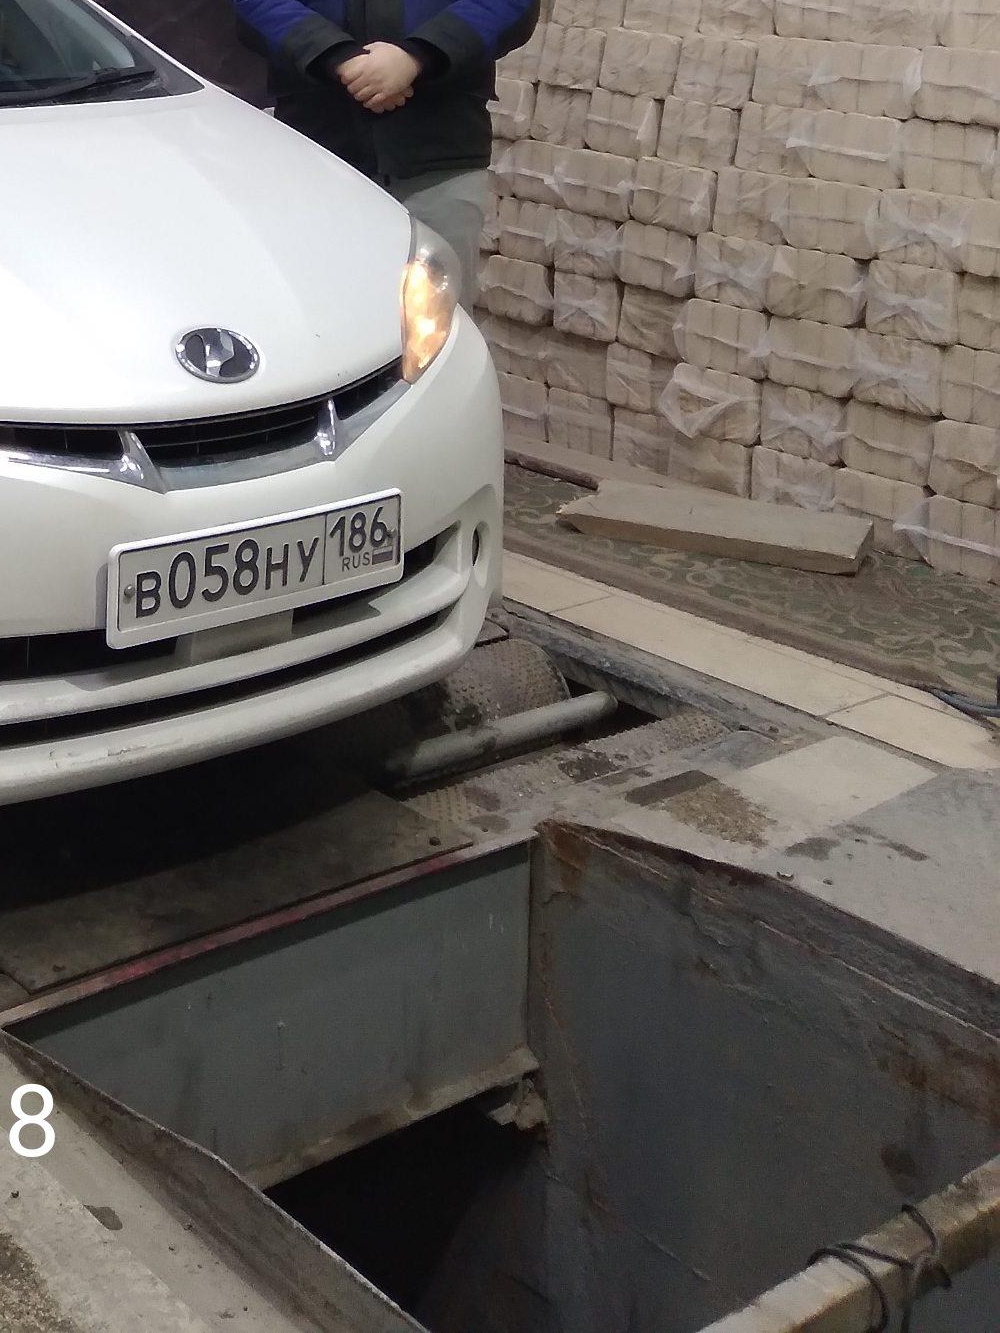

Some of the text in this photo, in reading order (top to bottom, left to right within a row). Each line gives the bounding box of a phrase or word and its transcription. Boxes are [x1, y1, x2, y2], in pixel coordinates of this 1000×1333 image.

[135, 506, 388, 619] В058НУ 186
[341, 551, 371, 572] RUS
